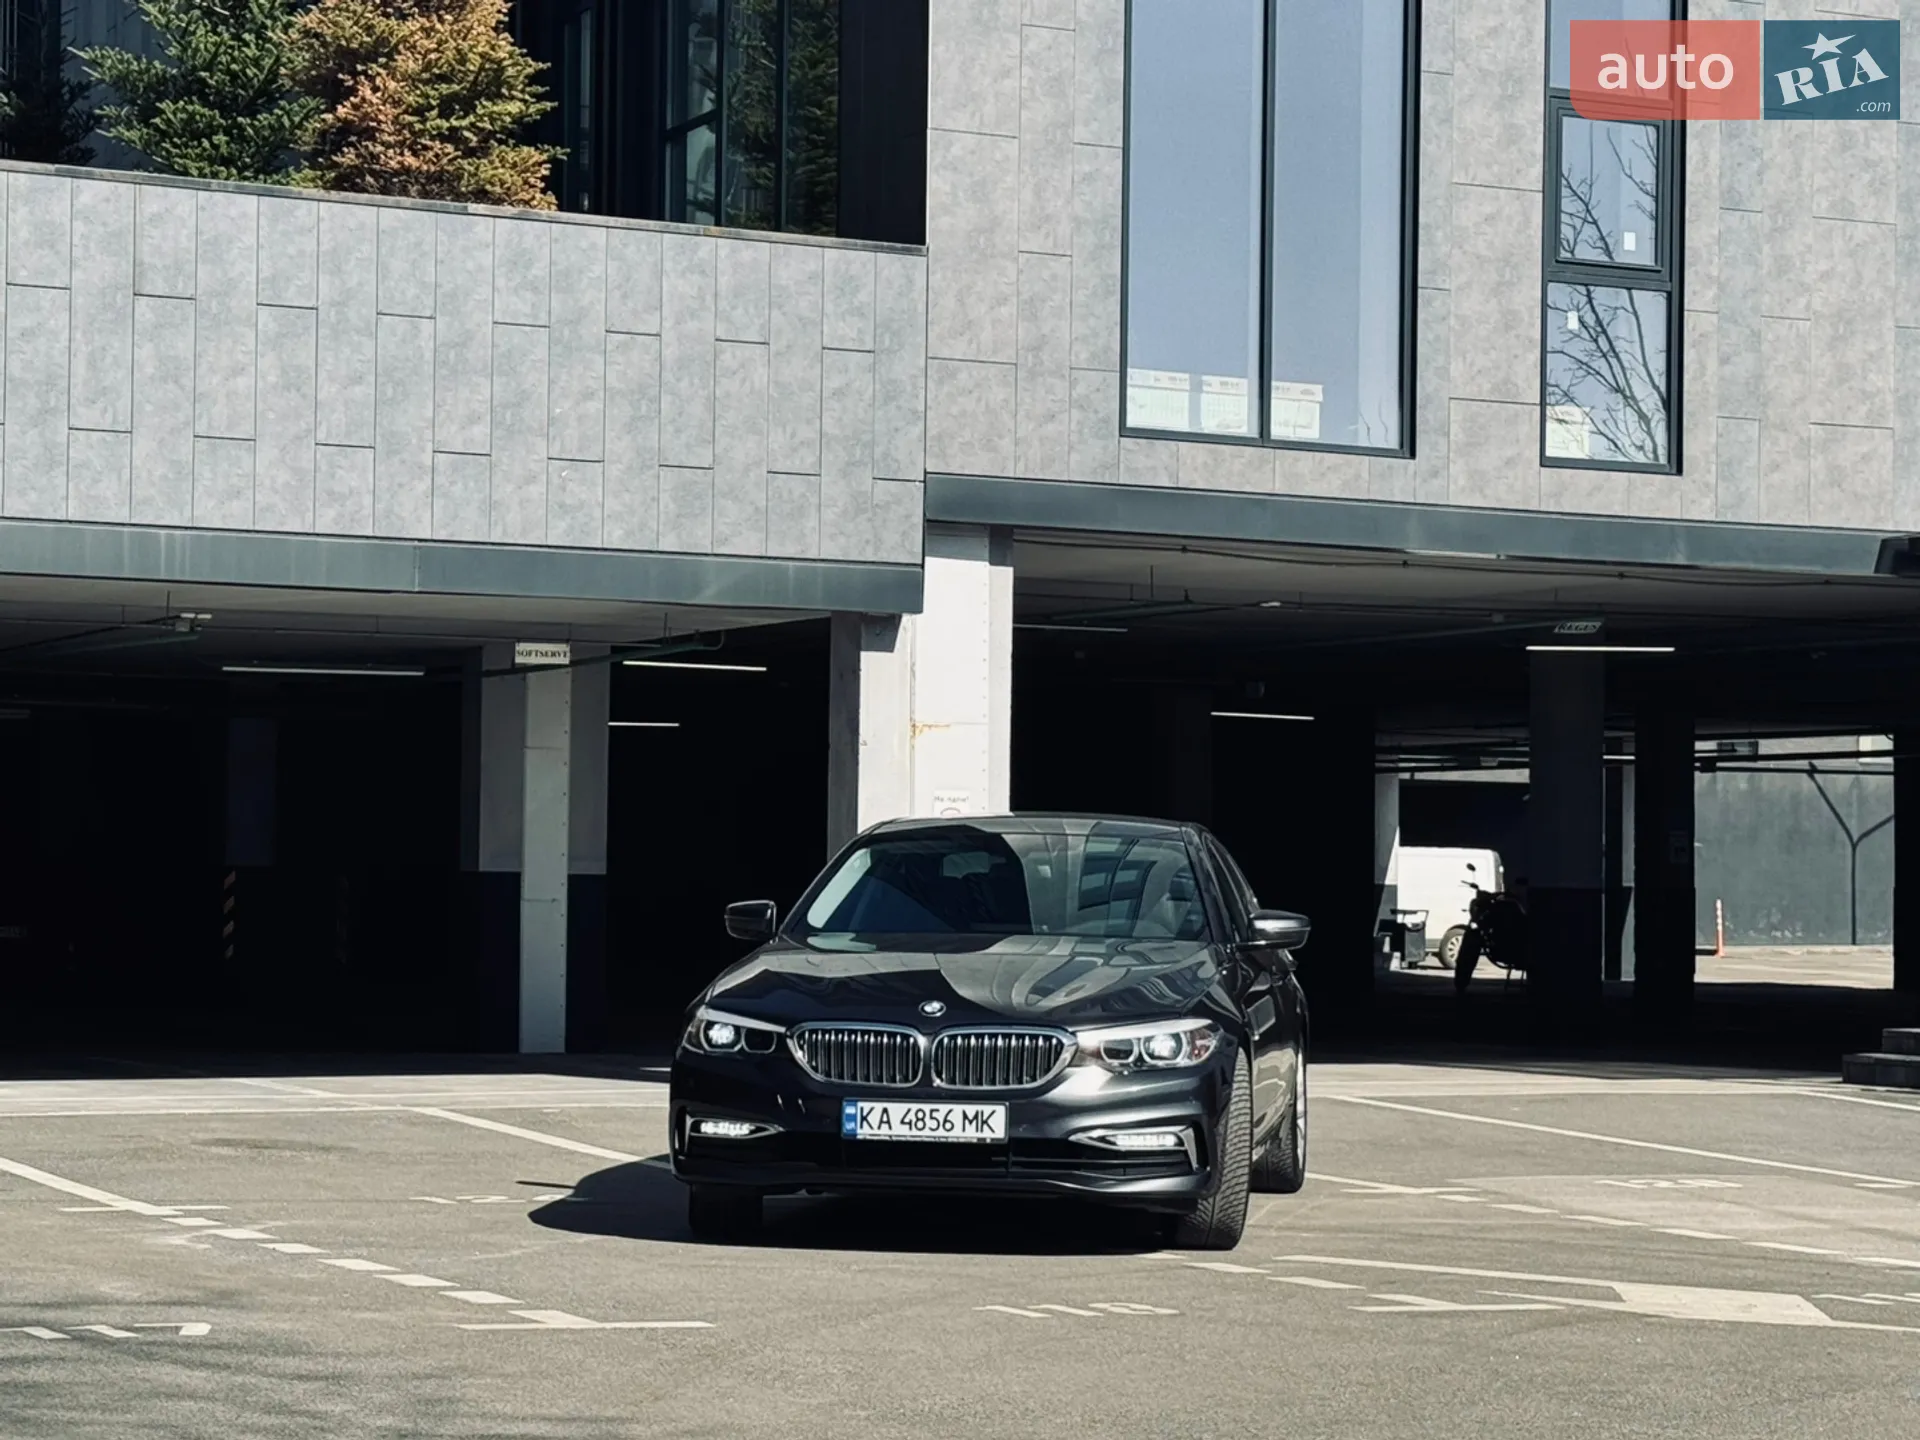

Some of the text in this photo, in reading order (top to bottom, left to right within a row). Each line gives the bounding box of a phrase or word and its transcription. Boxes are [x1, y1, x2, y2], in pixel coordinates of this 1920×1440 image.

[859, 1106, 997, 1134] KA 4856 MK
